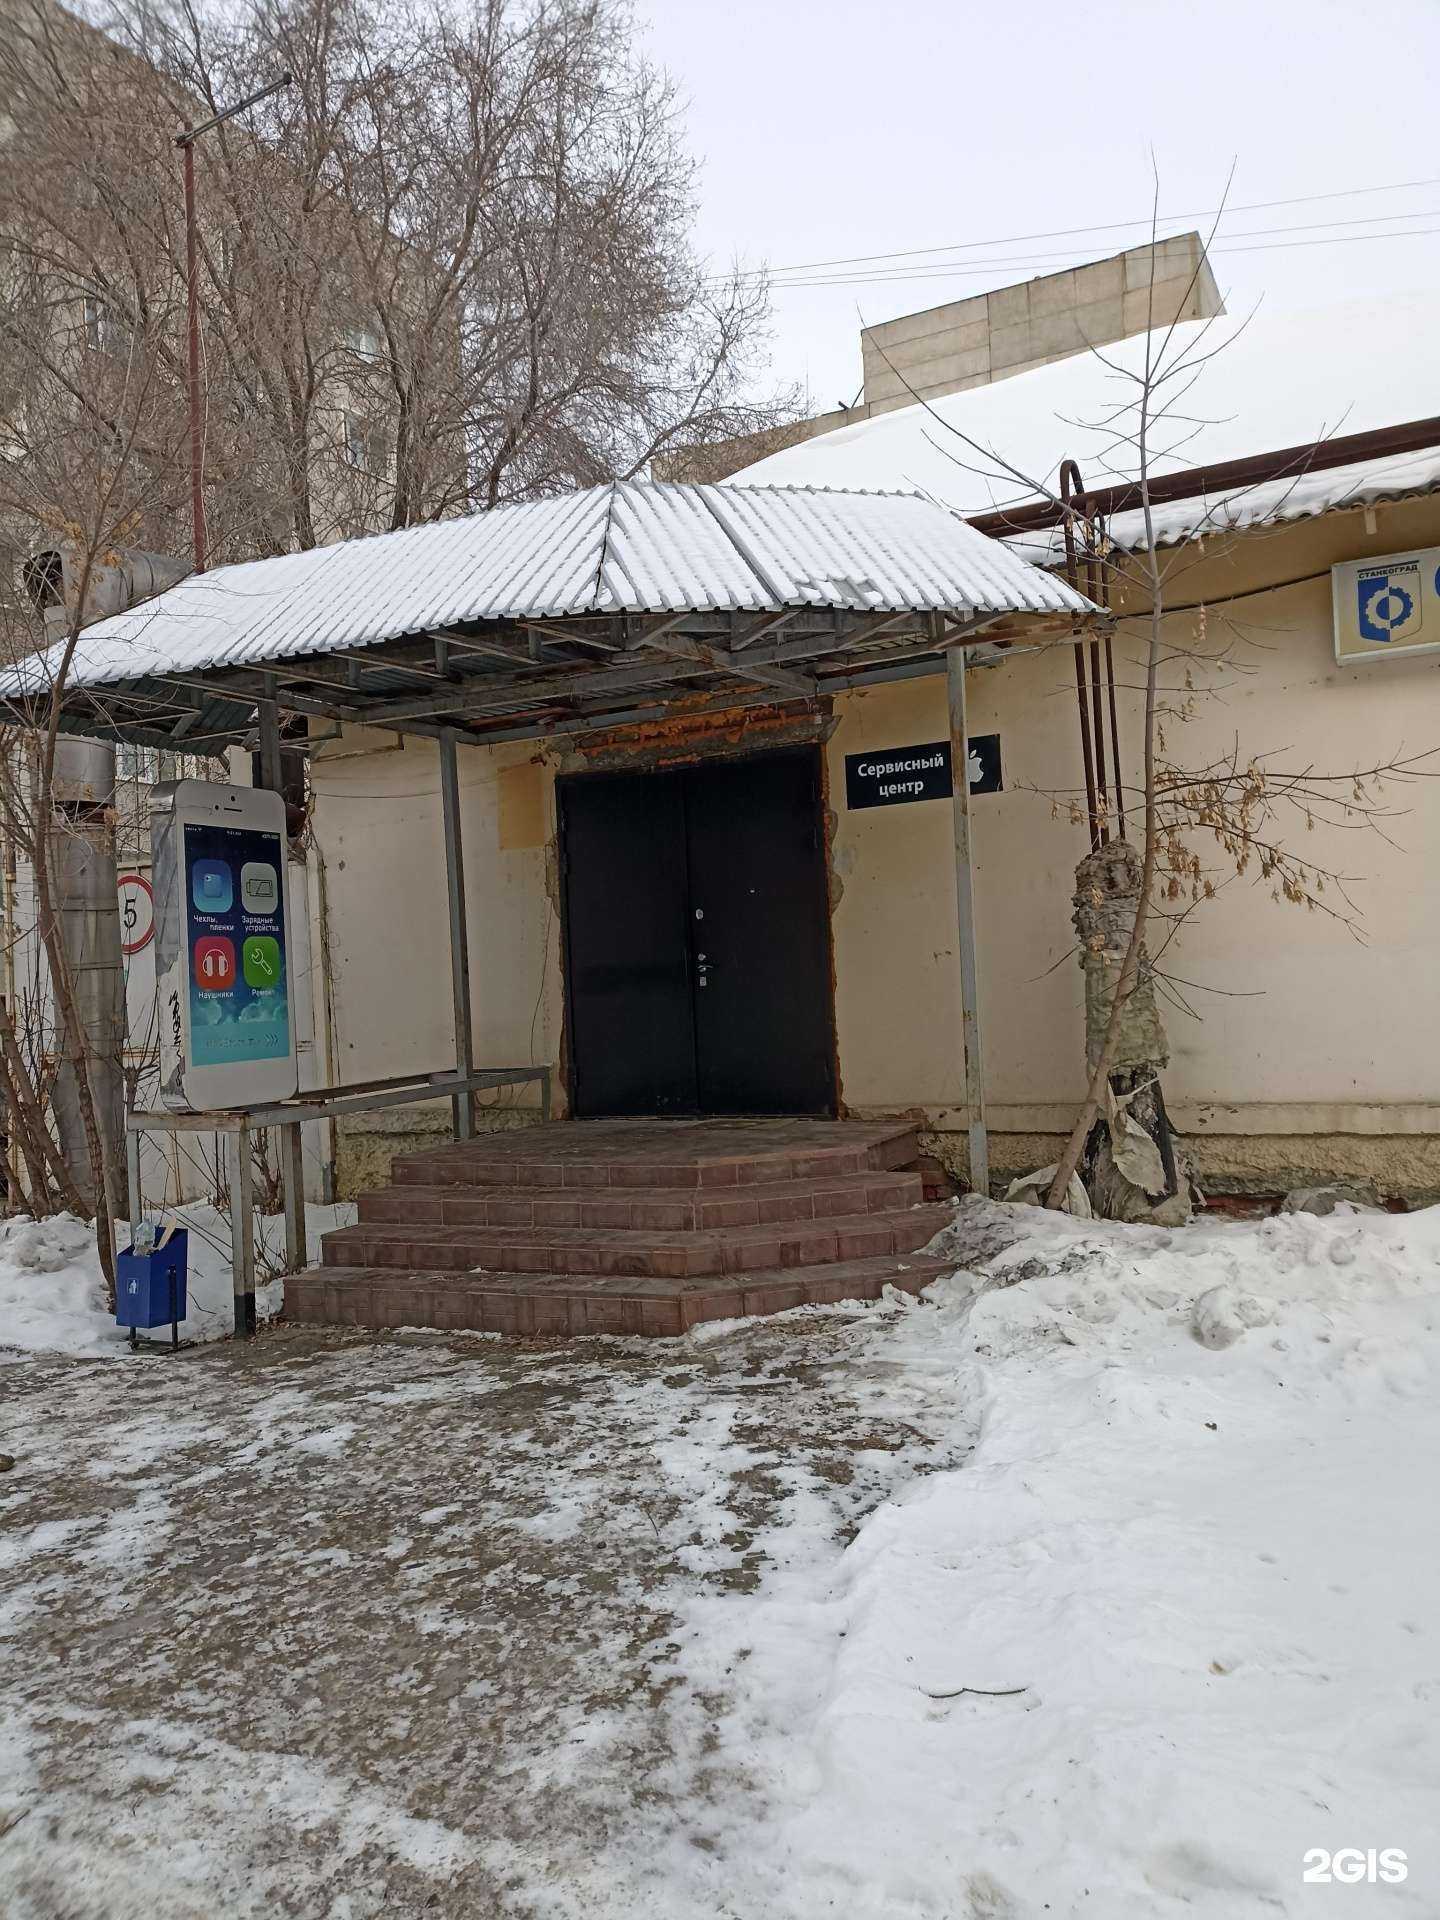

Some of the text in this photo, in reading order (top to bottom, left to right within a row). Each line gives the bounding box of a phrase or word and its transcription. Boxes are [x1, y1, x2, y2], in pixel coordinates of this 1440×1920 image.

[1358, 564, 1418, 579] СТАНКОГРАД
[858, 753, 944, 778] Сервисный
[879, 779, 924, 798] центр
[123, 898, 137, 929] 5
[193, 914, 218, 924] Чехлы,
[241, 915, 274, 925] Зарядные
[245, 924, 281, 933] устройства
[198, 990, 234, 1000] Наушники
